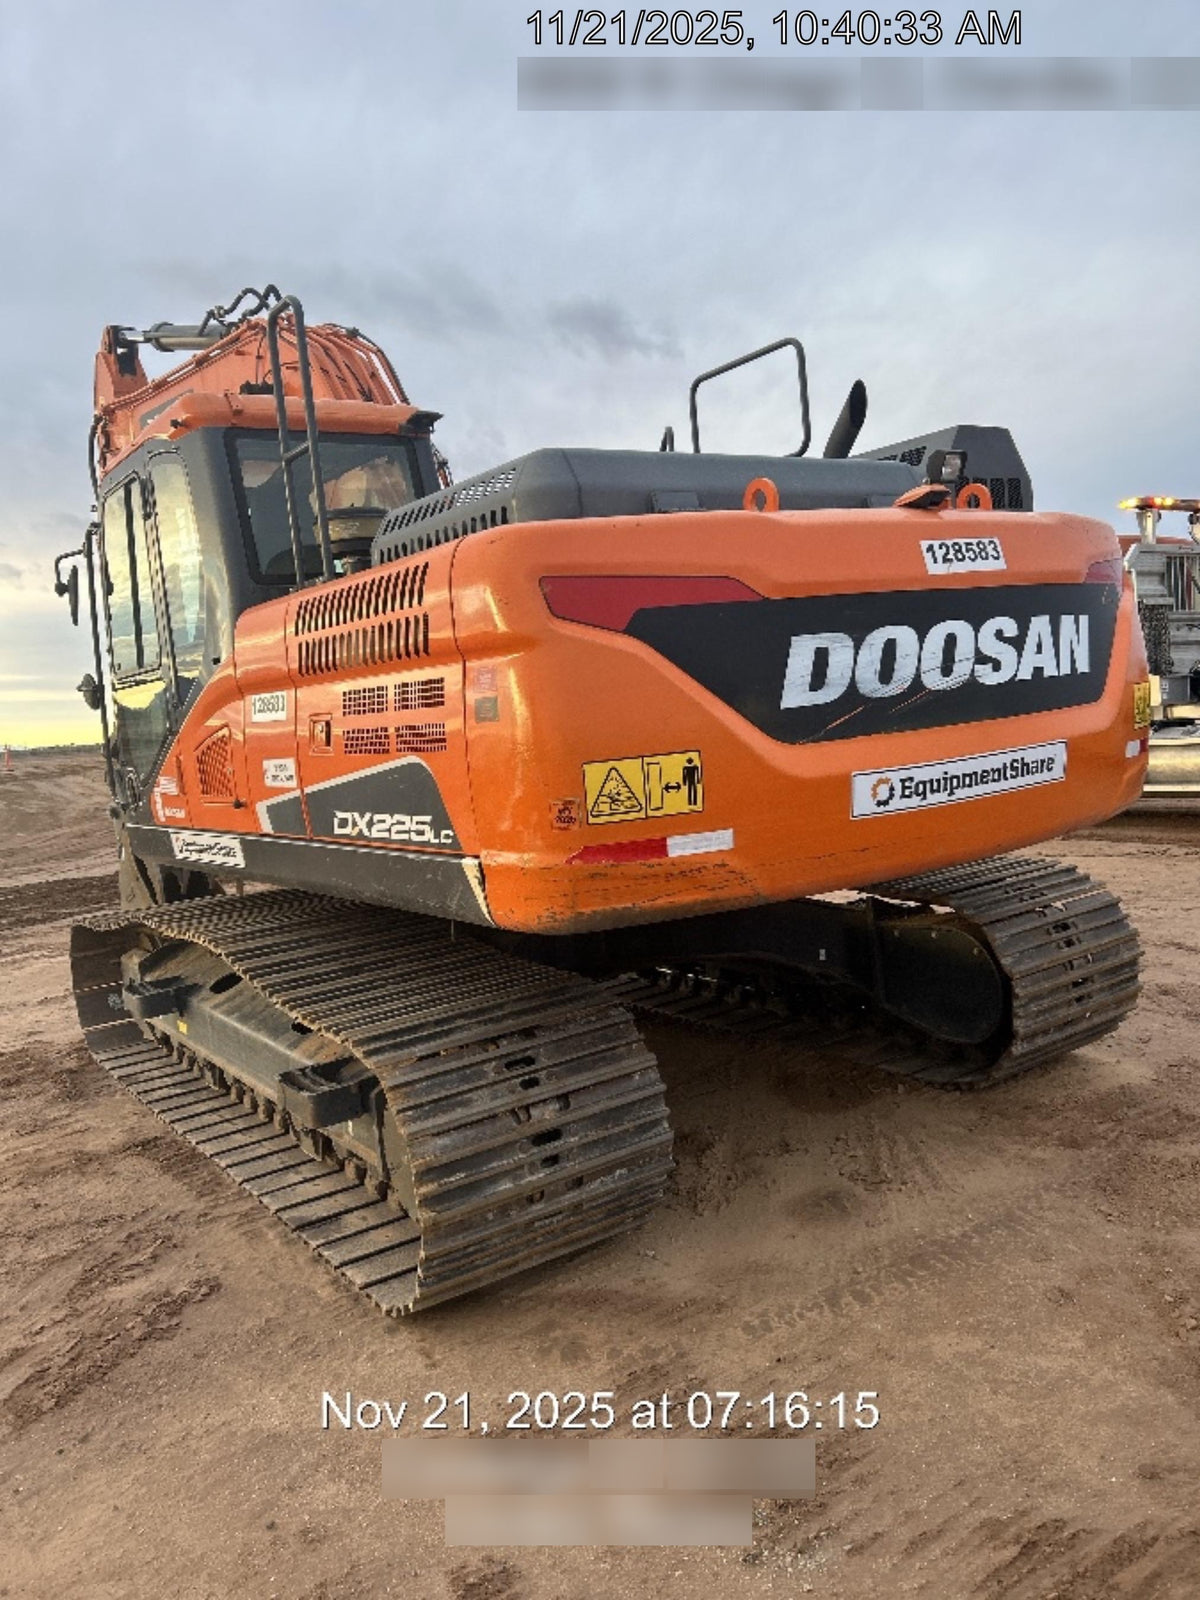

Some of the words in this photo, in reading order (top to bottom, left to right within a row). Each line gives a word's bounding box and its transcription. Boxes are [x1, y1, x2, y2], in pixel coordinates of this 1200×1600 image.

[925, 539, 1001, 564] 128583
[779, 614, 1091, 710] DOOSAN
[899, 755, 1056, 802] EquipmentShare
